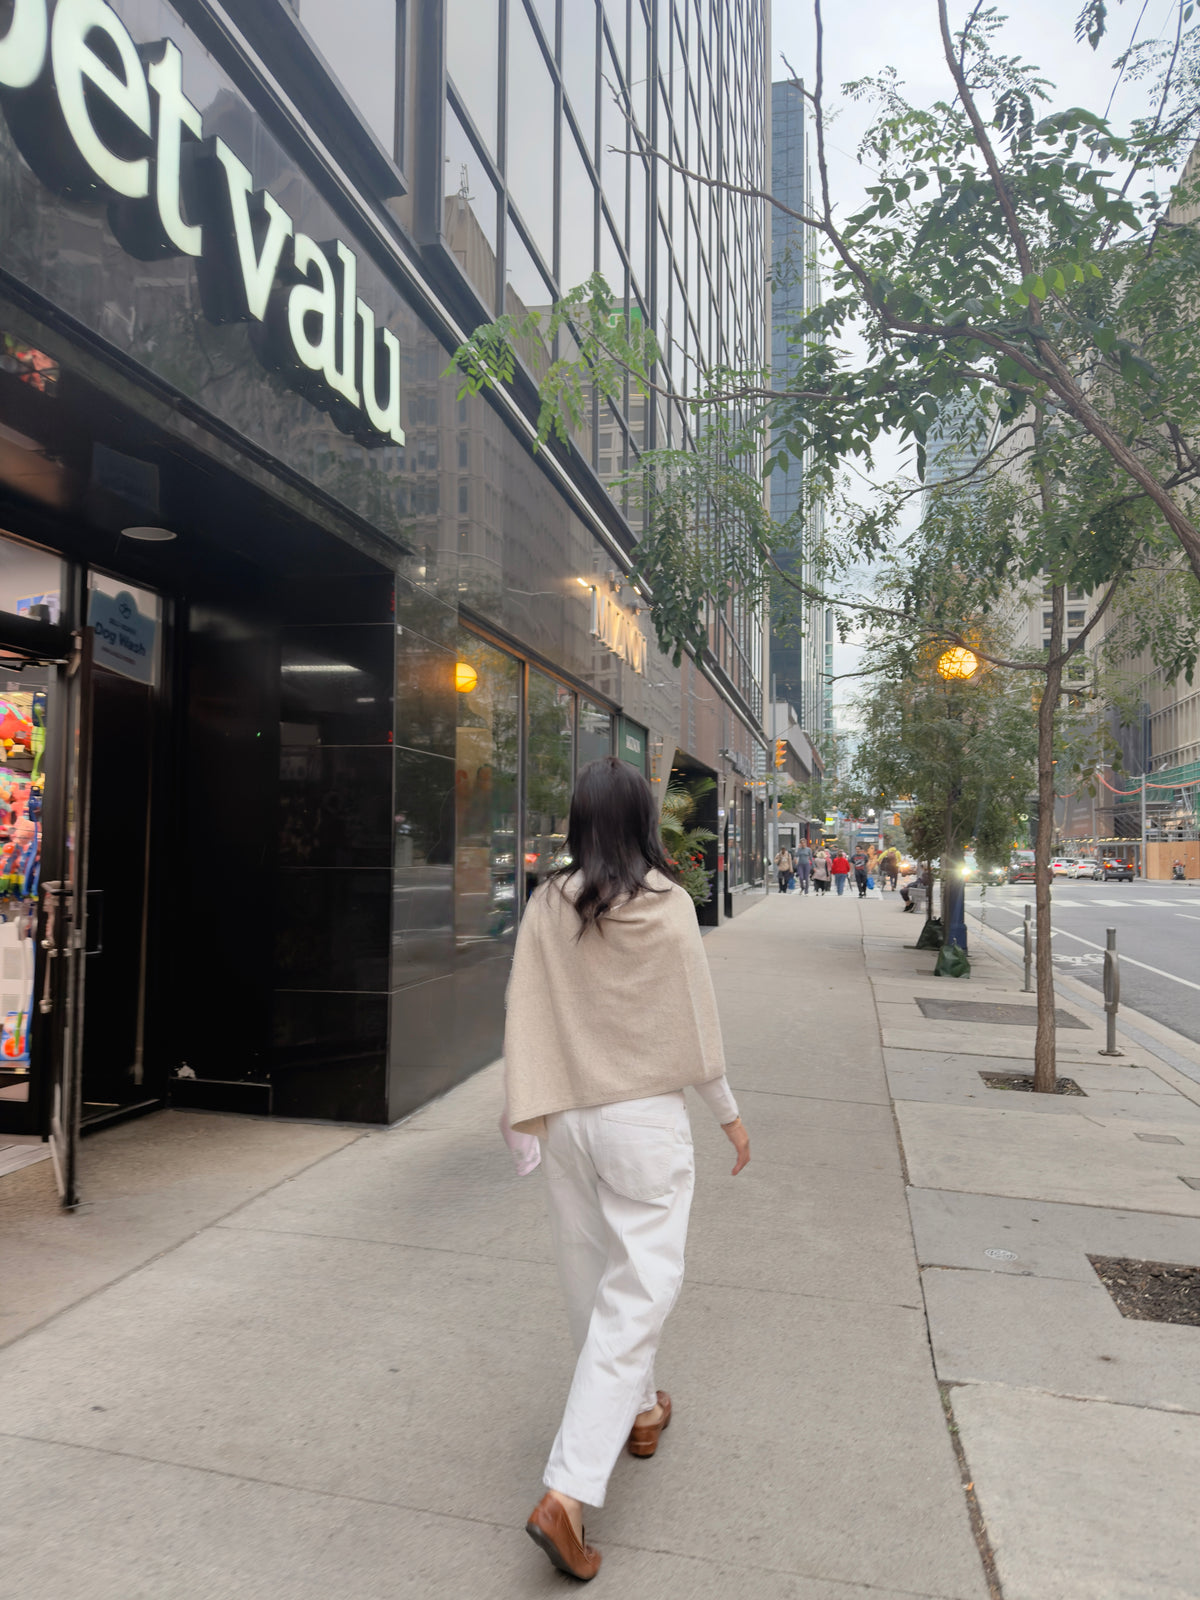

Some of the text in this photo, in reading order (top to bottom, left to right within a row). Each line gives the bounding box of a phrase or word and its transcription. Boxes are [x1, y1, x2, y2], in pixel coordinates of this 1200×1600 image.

[0, 0, 405, 447] et valu
[95, 621, 116, 645] Dog
[119, 633, 146, 656] Wash
